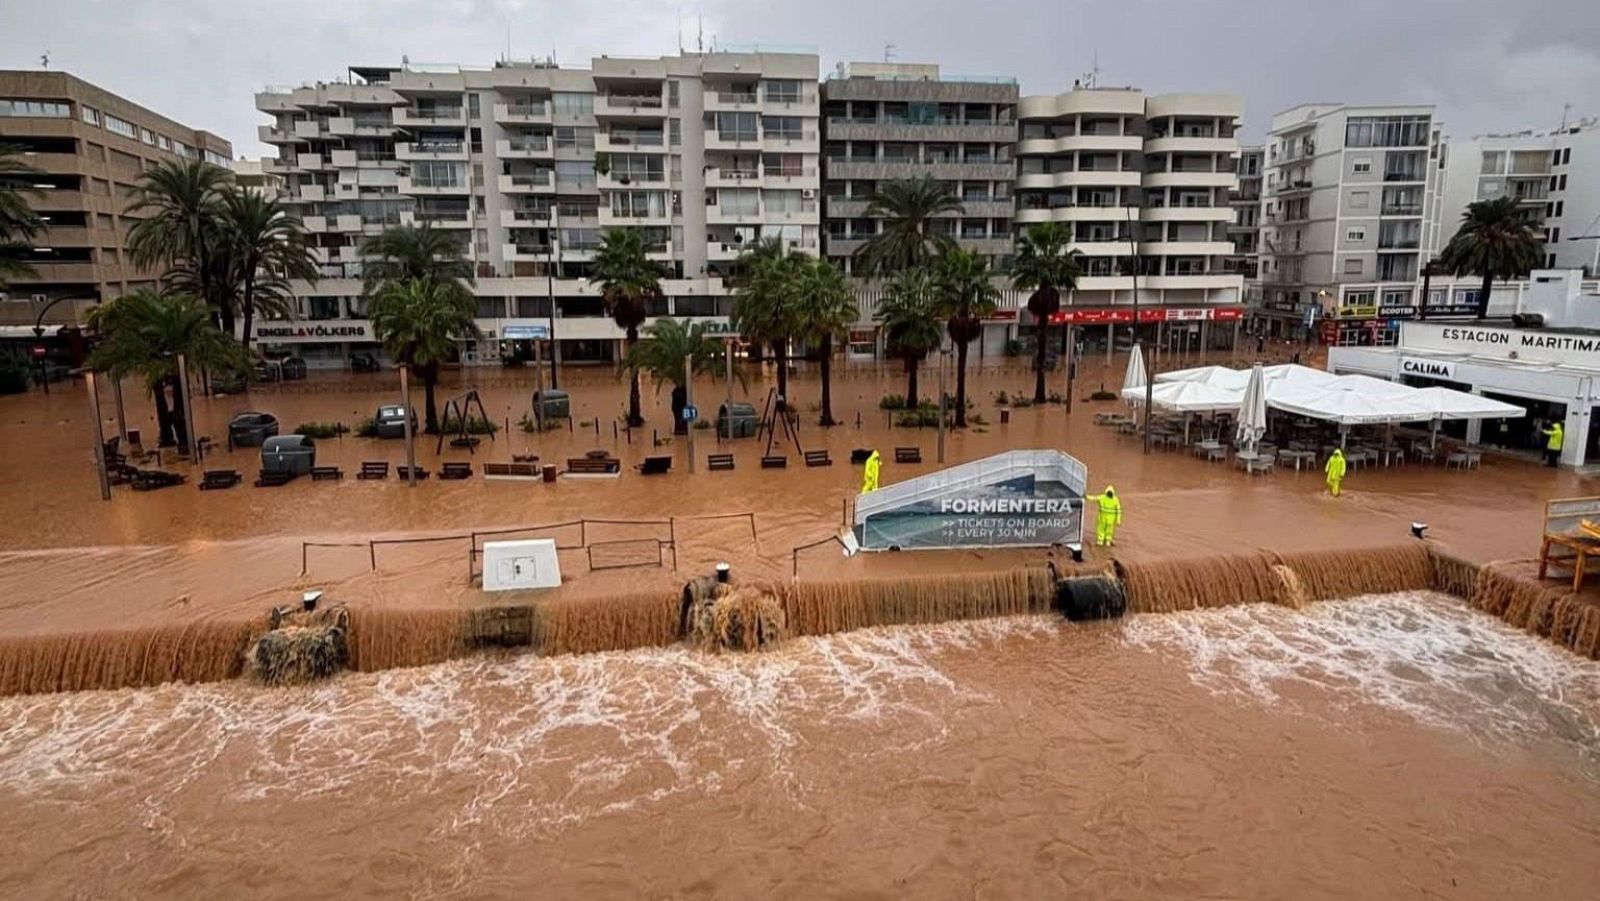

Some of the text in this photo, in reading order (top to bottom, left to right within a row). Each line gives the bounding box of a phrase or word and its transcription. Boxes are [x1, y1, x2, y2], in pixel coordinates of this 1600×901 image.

[1380, 307, 1414, 315] SCOOTER
[1443, 328, 1509, 344] ESTACION
[1403, 361, 1449, 377] CALIMA
[683, 410, 696, 419] B1
[941, 498, 1072, 513] FORMENTERA
[958, 518, 1070, 528] TICKETS ON BOARD
[957, 528, 1036, 538] EVERY 30 MIN
